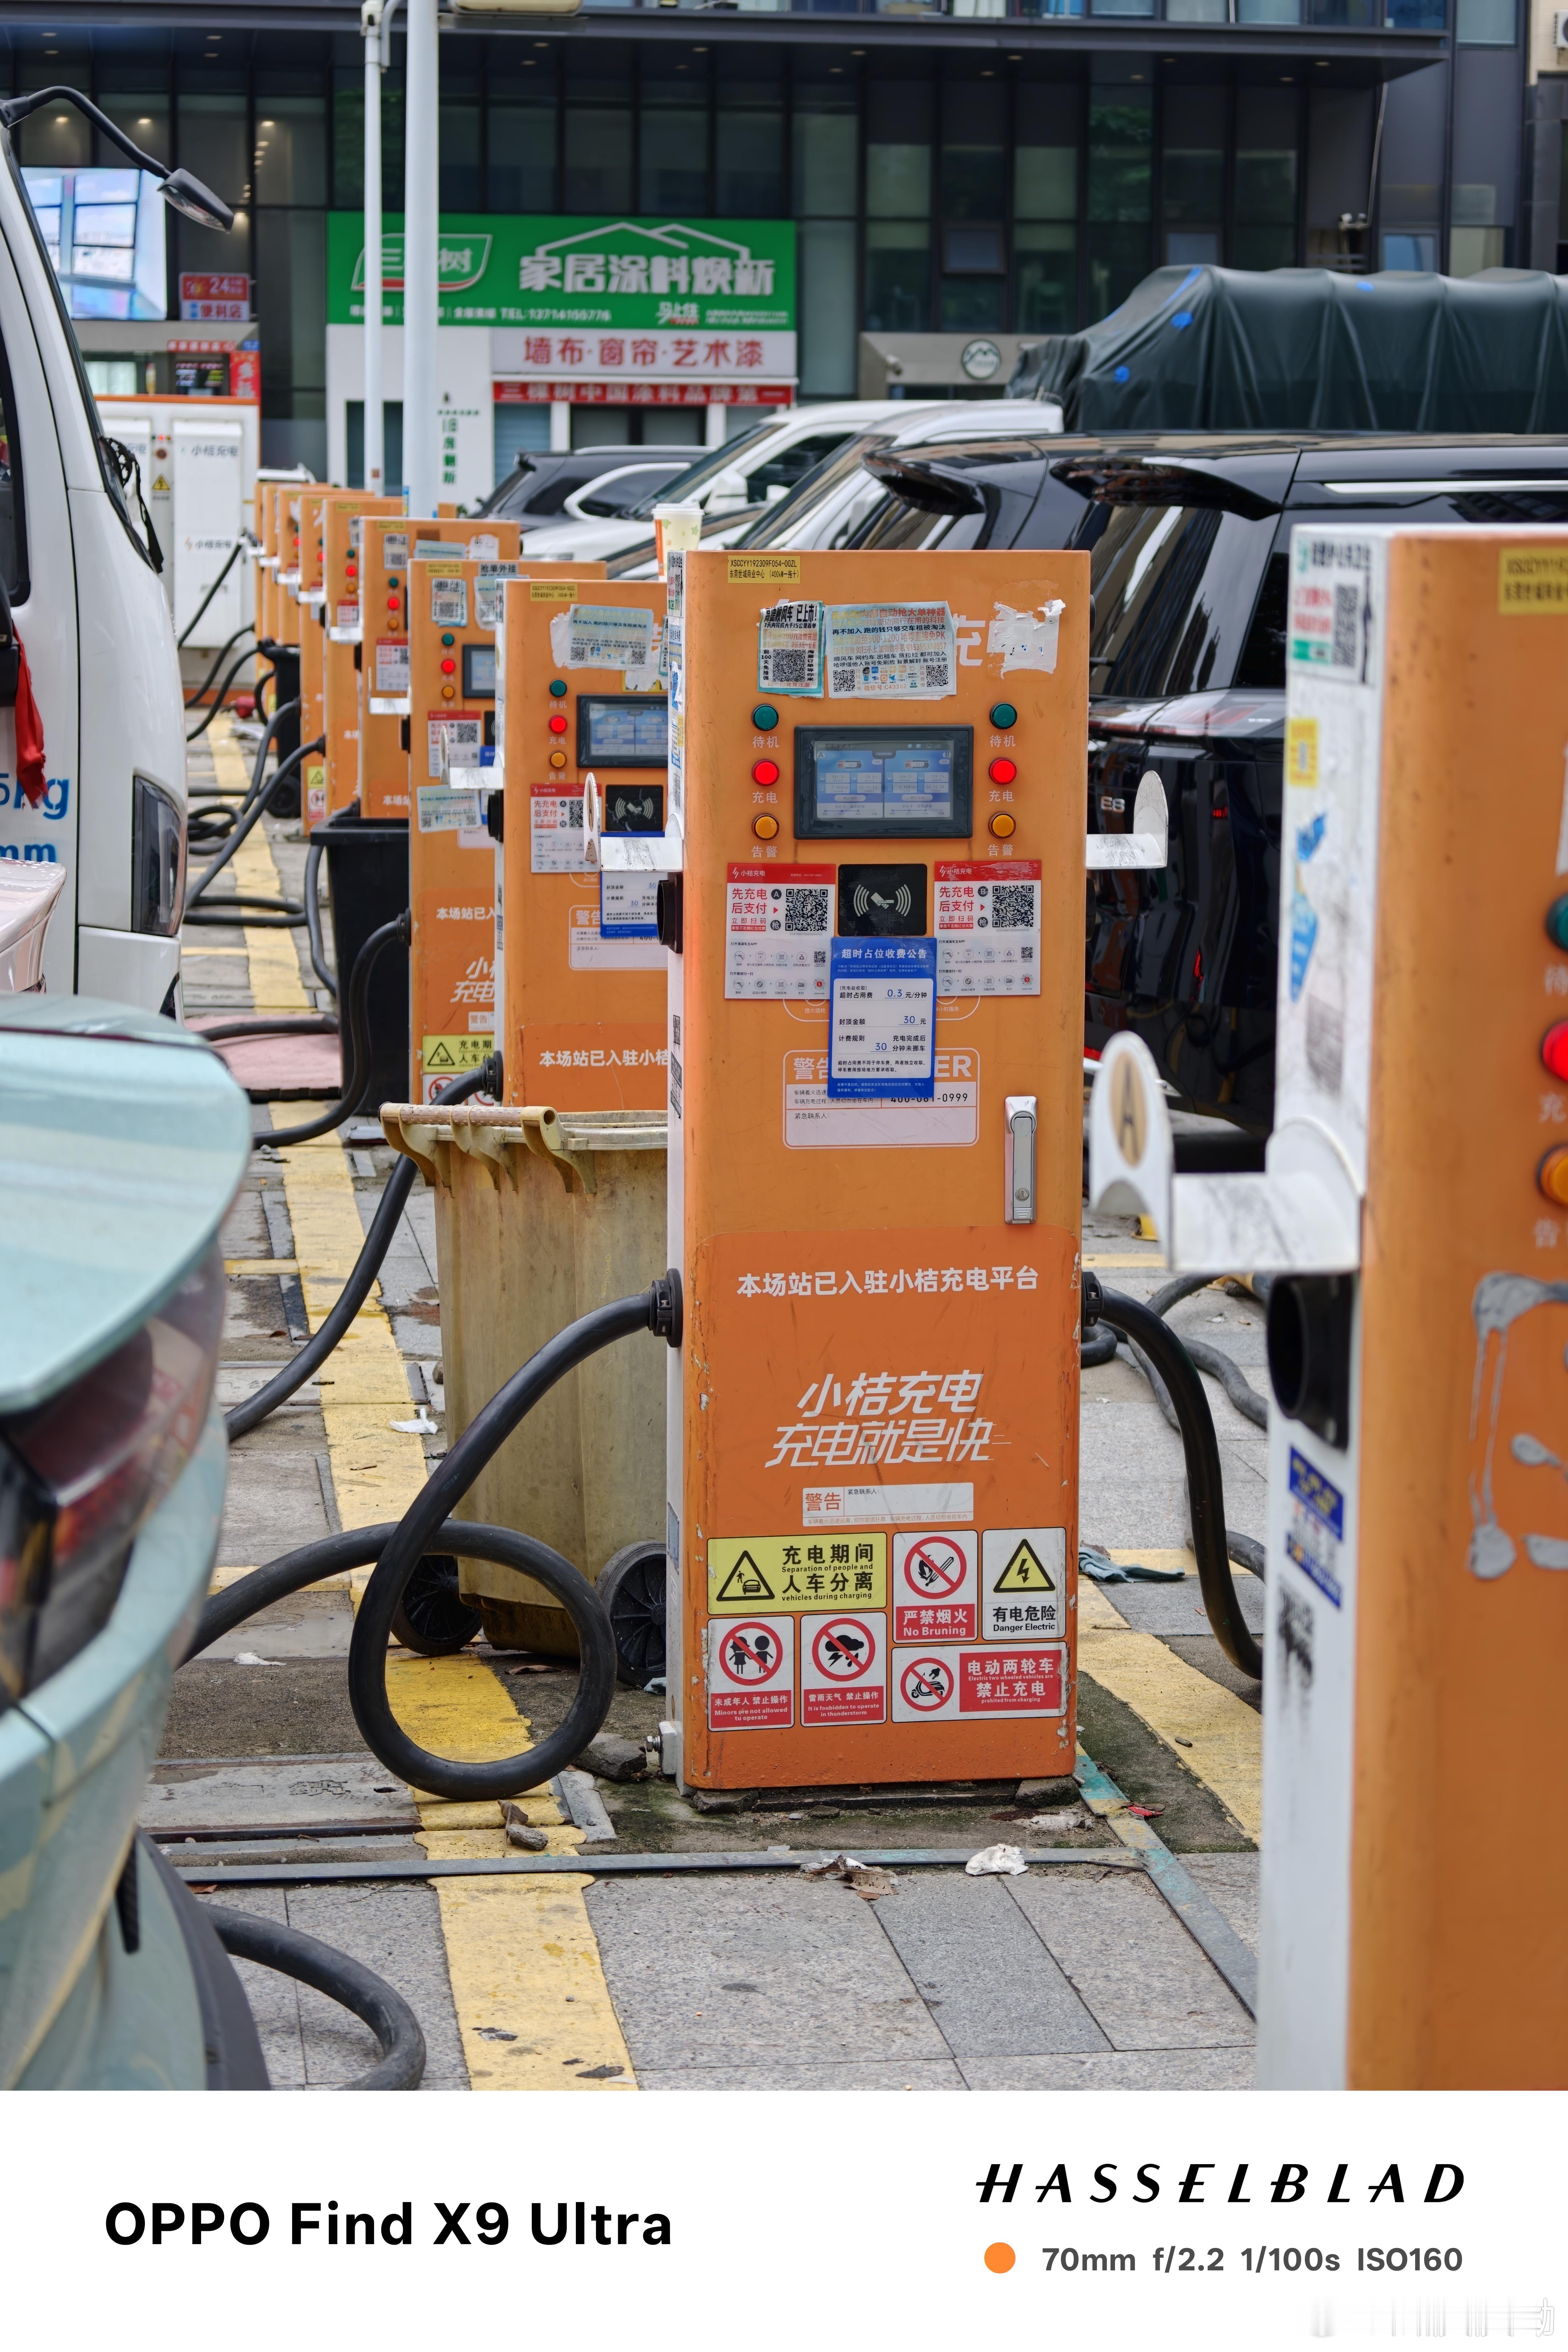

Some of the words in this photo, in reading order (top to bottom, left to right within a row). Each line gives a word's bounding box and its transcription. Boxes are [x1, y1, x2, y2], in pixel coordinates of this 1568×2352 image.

[519, 255, 775, 295] 家居涂料焕新
[209, 277, 229, 294] 24
[201, 304, 243, 318] 便利店
[500, 383, 785, 403] 三棵树中国涂料品牌第一
[191, 444, 239, 456] 小桔充电
[481, 564, 517, 573] 抢单外挂
[730, 569, 765, 578] 东莞世城商业中心
[864, 624, 946, 634] 跑的钱只够交车租被淘汰
[901, 630, 946, 643] 哈啰直接免PK
[856, 644, 877, 654] 如扫不上
[833, 659, 895, 668] 哈啰借他人账号免刷脸
[864, 683, 907, 691] 微信号:C43382
[549, 700, 567, 708] 待机
[549, 736, 566, 745] 充电
[752, 736, 779, 748] 待机
[990, 735, 1016, 747] 待机
[548, 772, 566, 780] 告警
[752, 791, 778, 803] 充电
[989, 790, 1014, 802] 充电
[1101, 796, 1125, 813] E8
[751, 846, 778, 858] 告警
[987, 844, 1014, 856] 告警
[732, 888, 768, 900] 先充电
[939, 886, 974, 898] 先充电
[731, 902, 767, 914] 后支付
[939, 900, 974, 912] 后支付
[576, 910, 601, 925] 警告
[842, 948, 927, 959] 超时占位收费公告
[887, 989, 902, 997] 0.3
[469, 1014, 488, 1024] 警告
[875, 1043, 887, 1051] 30
[793, 1057, 828, 1080] 警告
[1539, 1092, 1567, 1124] 充
[737, 1265, 1040, 1298] 本场站已入驻小桔充电平台
[796, 1369, 985, 1418] 小桔充电
[764, 1417, 995, 1469] 充电就是快
[805, 1492, 842, 1512] 警告
[782, 1543, 873, 1566] 充电期间
[833, 1564, 858, 1572] people
[782, 1571, 873, 1594] 人车分离
[903, 1609, 968, 1625] 严禁烟火
[993, 1605, 1056, 1622] 有电危险
[903, 1628, 919, 1636] No
[922, 1626, 966, 1636] Bruning
[993, 1624, 1023, 1633] Danger
[1025, 1623, 1055, 1631] Electric
[968, 1657, 1054, 1676] 电动两轮车
[976, 1680, 1046, 1698] 禁止充电
[714, 1698, 750, 1706] 未成年人
[752, 1695, 788, 1705] 禁止操作
[808, 1693, 842, 1702] 雷雨天气
[846, 1691, 879, 1700] 禁止操作
